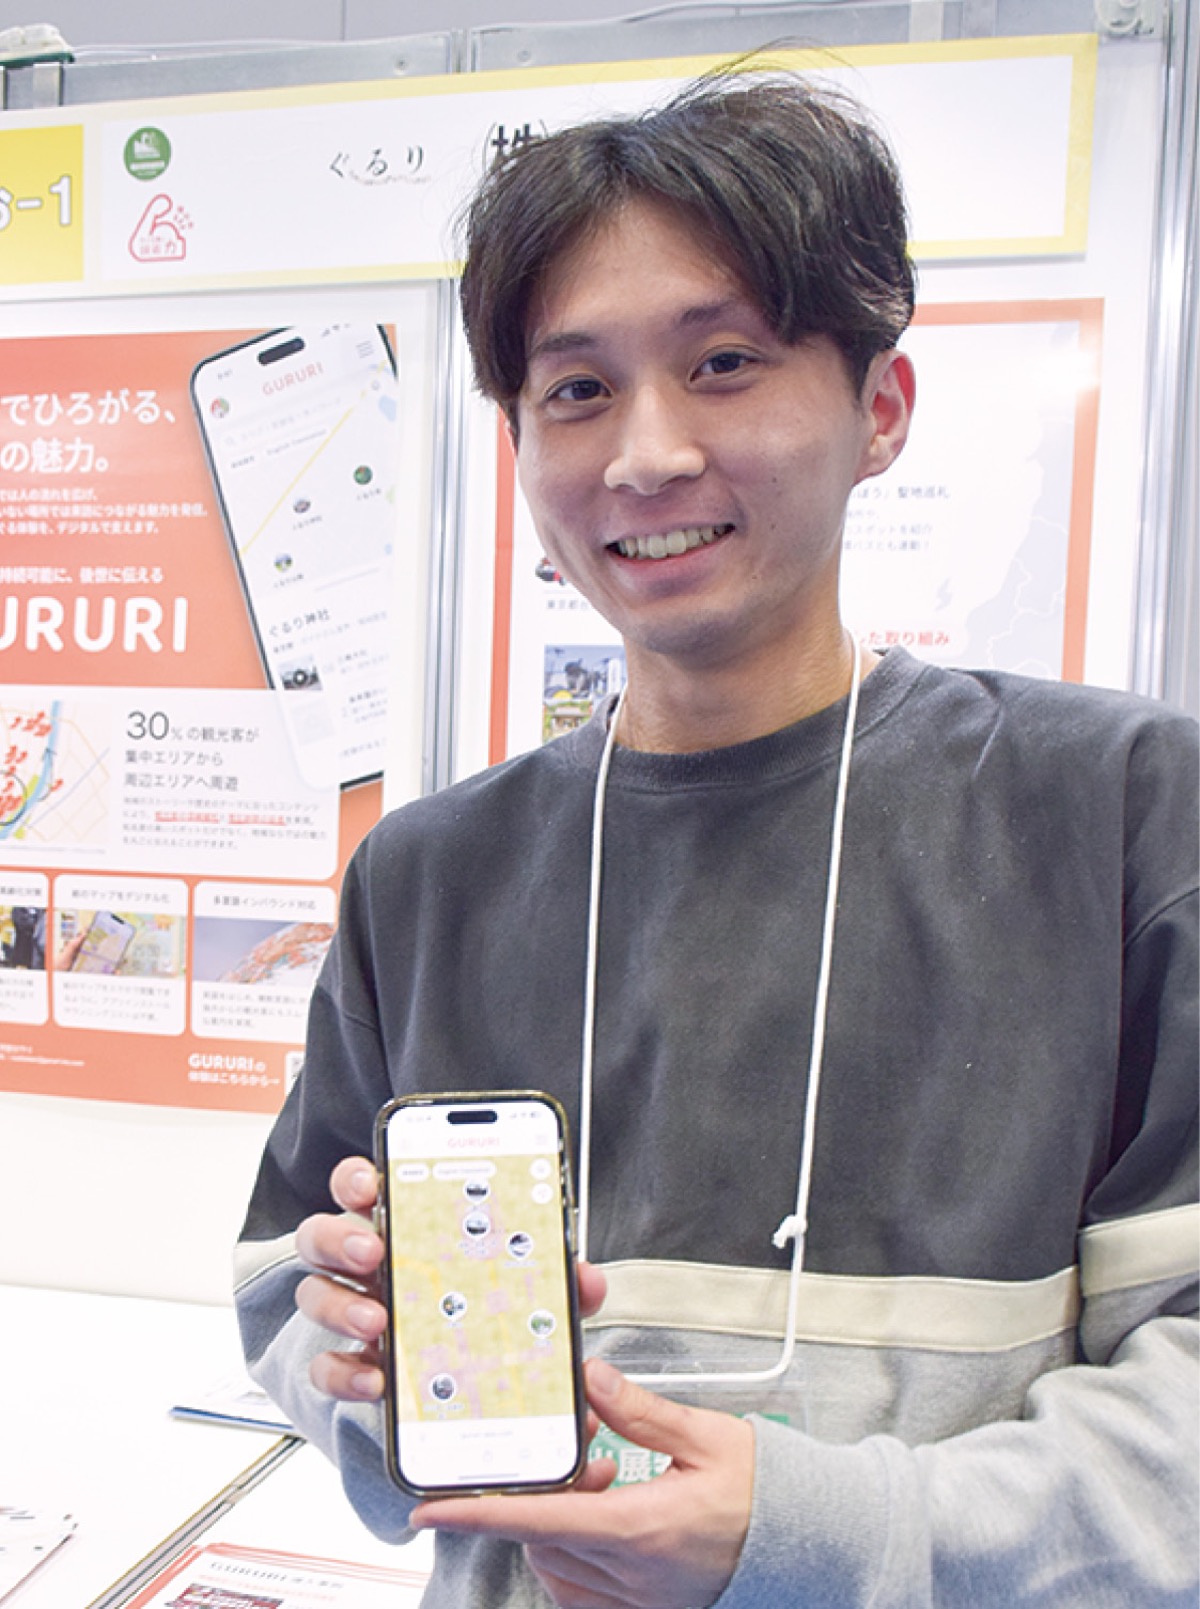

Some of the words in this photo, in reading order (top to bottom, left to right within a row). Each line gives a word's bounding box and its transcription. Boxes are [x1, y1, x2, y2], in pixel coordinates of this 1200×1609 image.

[330, 145, 424, 178] ぐるり
[262, 361, 325, 396] GURURI
[0, 389, 176, 426] でひろがる、
[0, 436, 110, 473] の魅力。
[125, 749, 224, 767] 集中エリアから
[447, 1136, 500, 1148] GURURI
